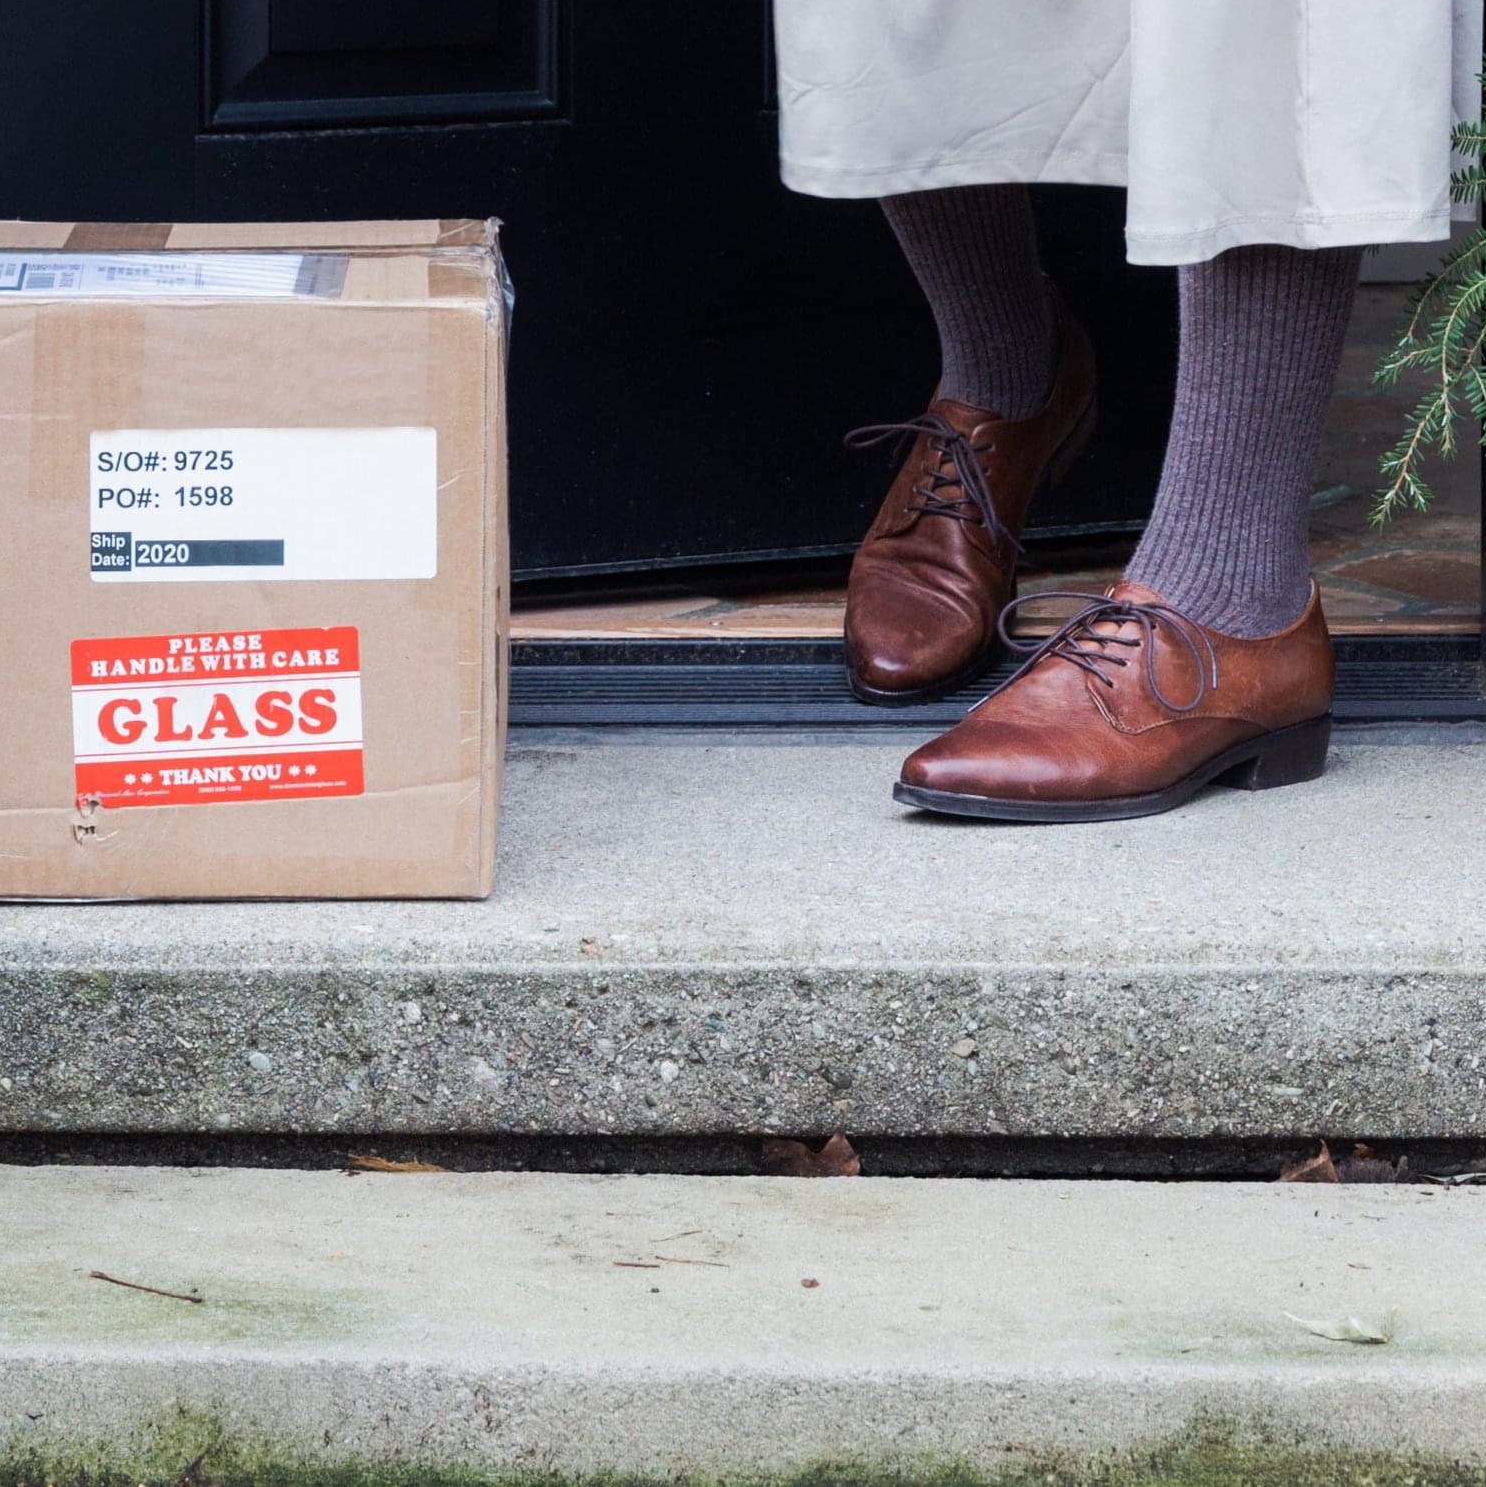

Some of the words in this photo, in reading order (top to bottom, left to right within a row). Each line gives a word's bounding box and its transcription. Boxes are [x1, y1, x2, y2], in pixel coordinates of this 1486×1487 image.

[97, 451, 167, 472] S/O#:
[173, 449, 234, 471] 9725
[97, 487, 160, 509] PO#:
[174, 485, 234, 507] 1598
[91, 533, 126, 550] Ship
[91, 552, 130, 566] Date:
[136, 543, 190, 564] 2020
[168, 634, 263, 654] PLEASE
[89, 655, 196, 677] HANDLE
[200, 652, 266, 672] WITH
[271, 648, 340, 669] CARE
[97, 688, 338, 745] GLASS
[158, 765, 236, 786] THANK
[239, 762, 282, 782] YOU
